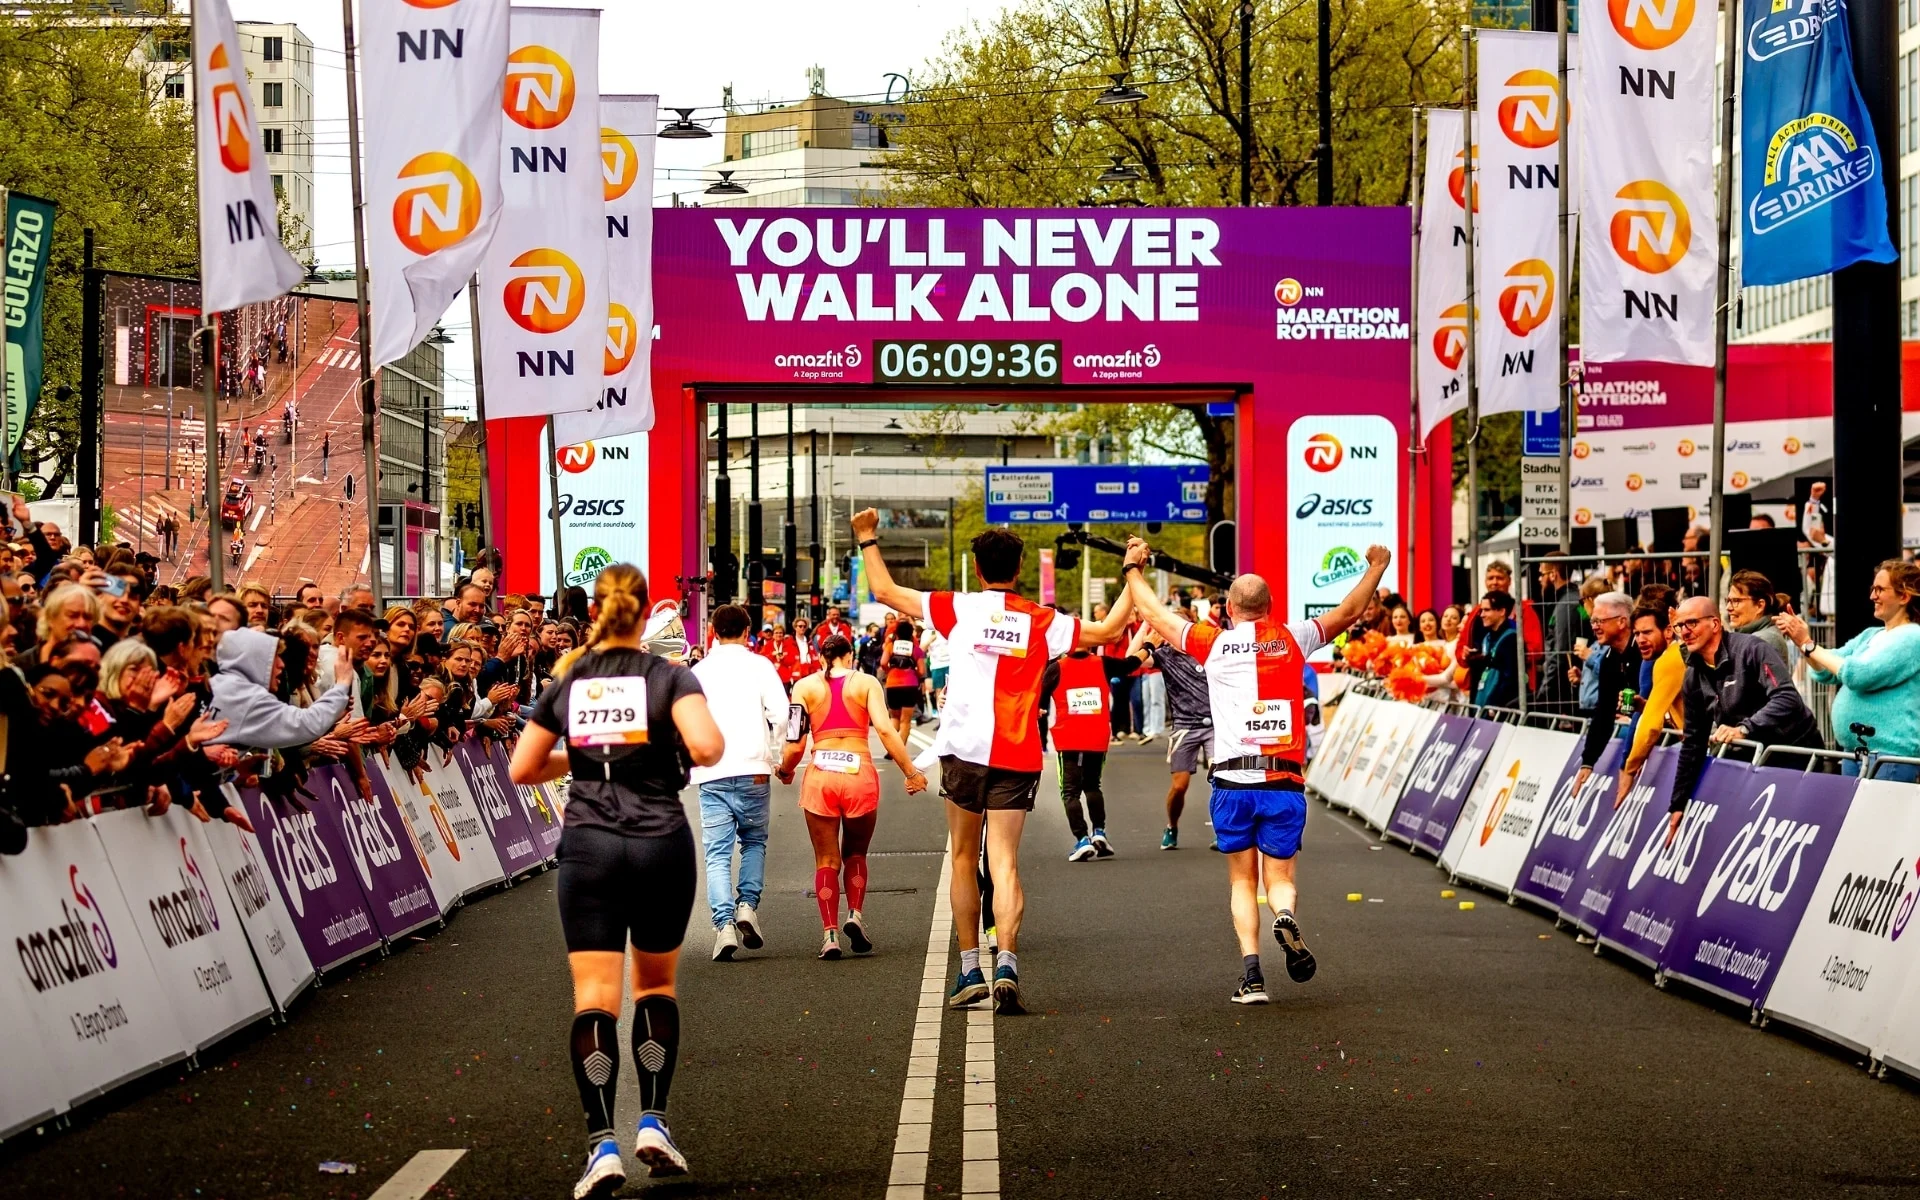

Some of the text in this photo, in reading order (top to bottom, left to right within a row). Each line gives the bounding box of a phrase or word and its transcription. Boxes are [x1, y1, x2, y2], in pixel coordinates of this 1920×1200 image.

[397, 28, 464, 62] NN
[1619, 66, 1676, 99] NN
[1821, 116, 1851, 140] DRINK
[510, 146, 566, 173] NN
[1788, 135, 1845, 186] AA
[1508, 164, 1559, 190] NN
[1780, 161, 1858, 213] DRINK
[606, 215, 628, 238] N
[714, 217, 1222, 267] YOU'LL NEVER
[5, 209, 44, 329] GOLAZO
[736, 272, 1199, 322] WALK ALONE
[1305, 287, 1324, 297] NN
[1276, 307, 1400, 323] MARATHON
[1623, 289, 1678, 322] NN
[1276, 323, 1409, 340] ROTTERDAM
[516, 350, 574, 377] NN
[775, 349, 843, 368] amazfit
[880, 343, 1057, 378] 06:09:36
[1073, 349, 1142, 368] amazfit
[1502, 350, 1535, 377] NN
[800, 371, 819, 380] Zepp
[1092, 371, 1142, 380] A Zepp Brand
[1578, 391, 1667, 407] OTTERDAM
[602, 447, 629, 459] NN
[1351, 446, 1377, 459] NN
[1523, 464, 1560, 474] Stadhu
[573, 499, 625, 516] asics
[1321, 499, 1373, 515] asics
[1536, 508, 1557, 516] TAXI
[1524, 527, 1559, 537] 23-06
[585, 555, 605, 571] AA
[1334, 555, 1353, 571] AA
[983, 628, 1021, 643] 17421
[578, 708, 636, 725] 27739
[1245, 720, 1287, 731] 15476
[821, 752, 854, 763] 11226
[350, 795, 402, 868] asics
[281, 811, 338, 891] asics
[1727, 817, 1821, 912] asics
[149, 866, 213, 949] amazfit
[1829, 857, 1908, 938] amazfit
[16, 898, 105, 993] amazfit
[1842, 960, 1872, 991] Brand
